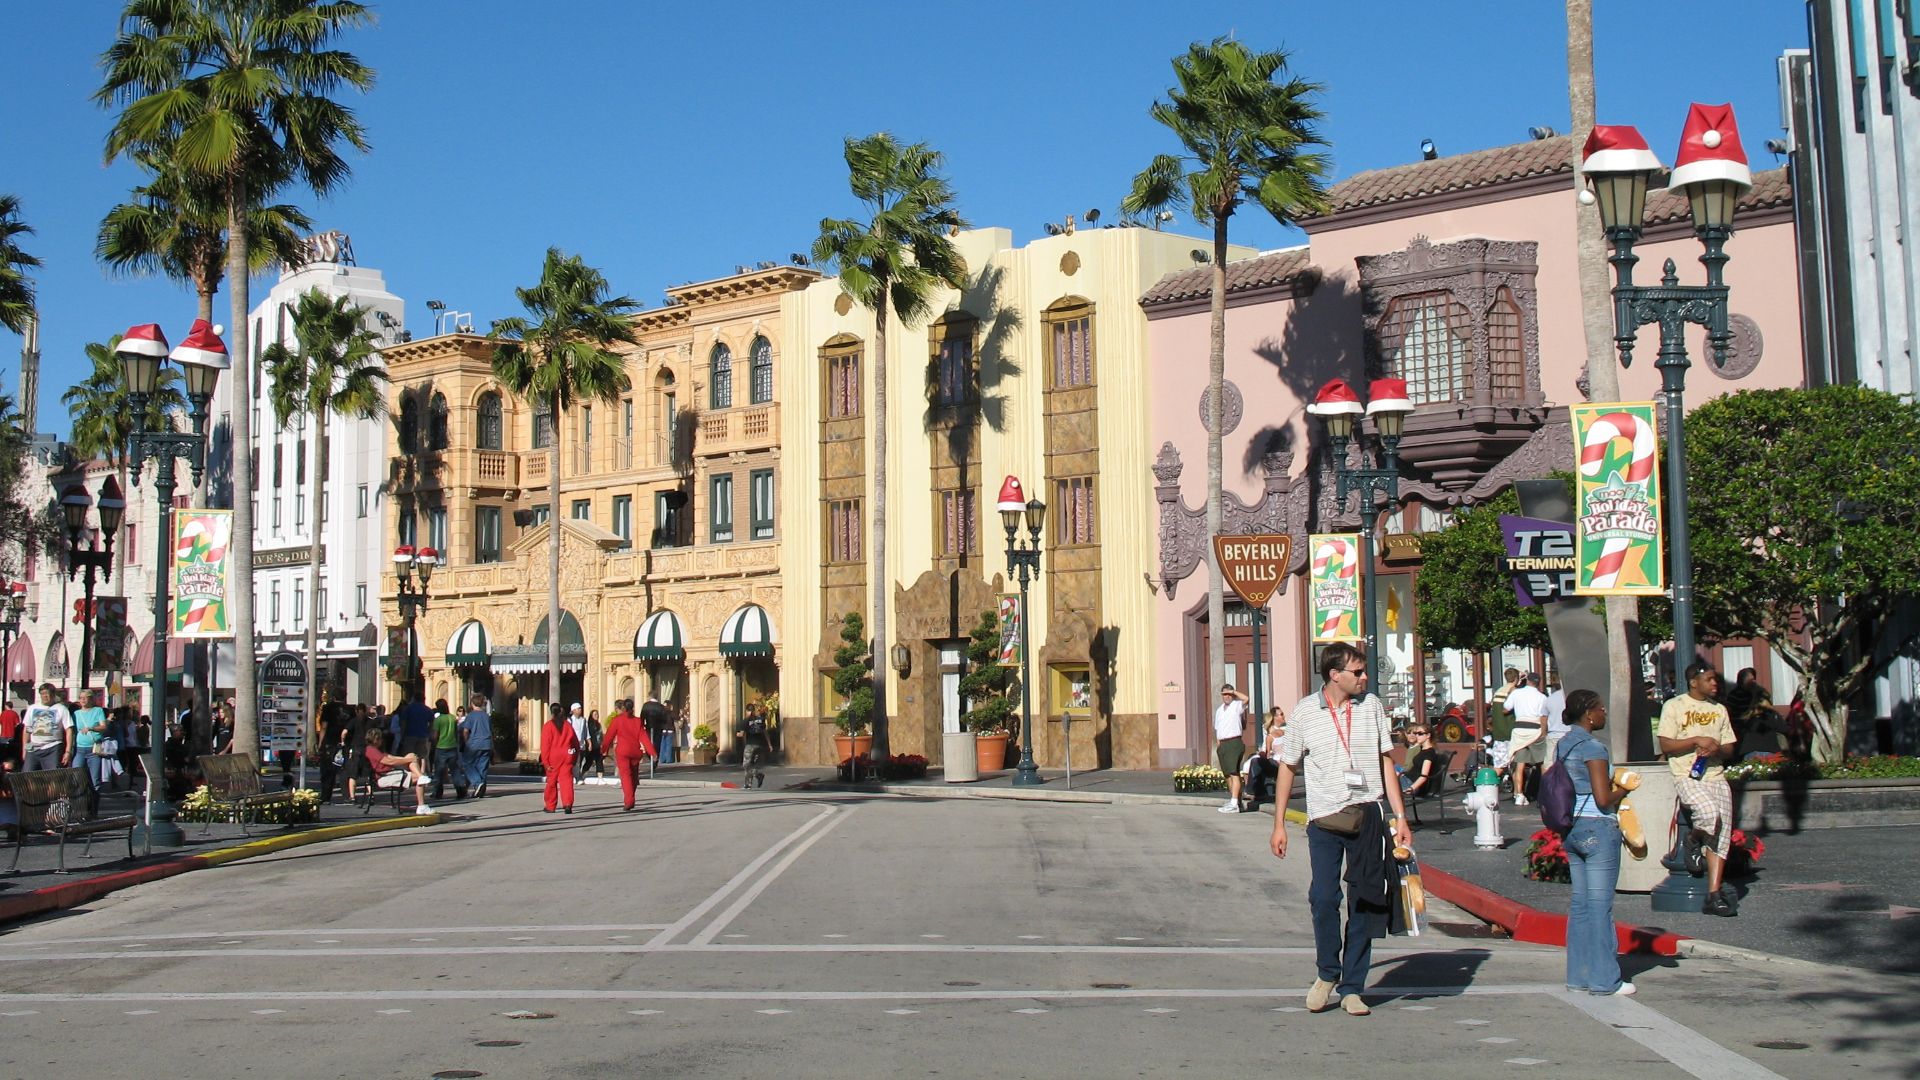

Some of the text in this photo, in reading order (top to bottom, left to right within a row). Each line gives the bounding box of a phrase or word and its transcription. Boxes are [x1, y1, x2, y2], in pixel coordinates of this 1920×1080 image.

[1589, 499, 1648, 516] Holiday
[1580, 510, 1657, 536] Parade
[1514, 530, 1574, 556] T2
[1224, 543, 1286, 561] BEVERLY
[1506, 557, 1577, 570] TERMINA
[1235, 564, 1277, 582] HILLS
[177, 582, 224, 597] Parade
[268, 668, 302, 677] DIRECTORY
[274, 660, 297, 668] STUDIO
